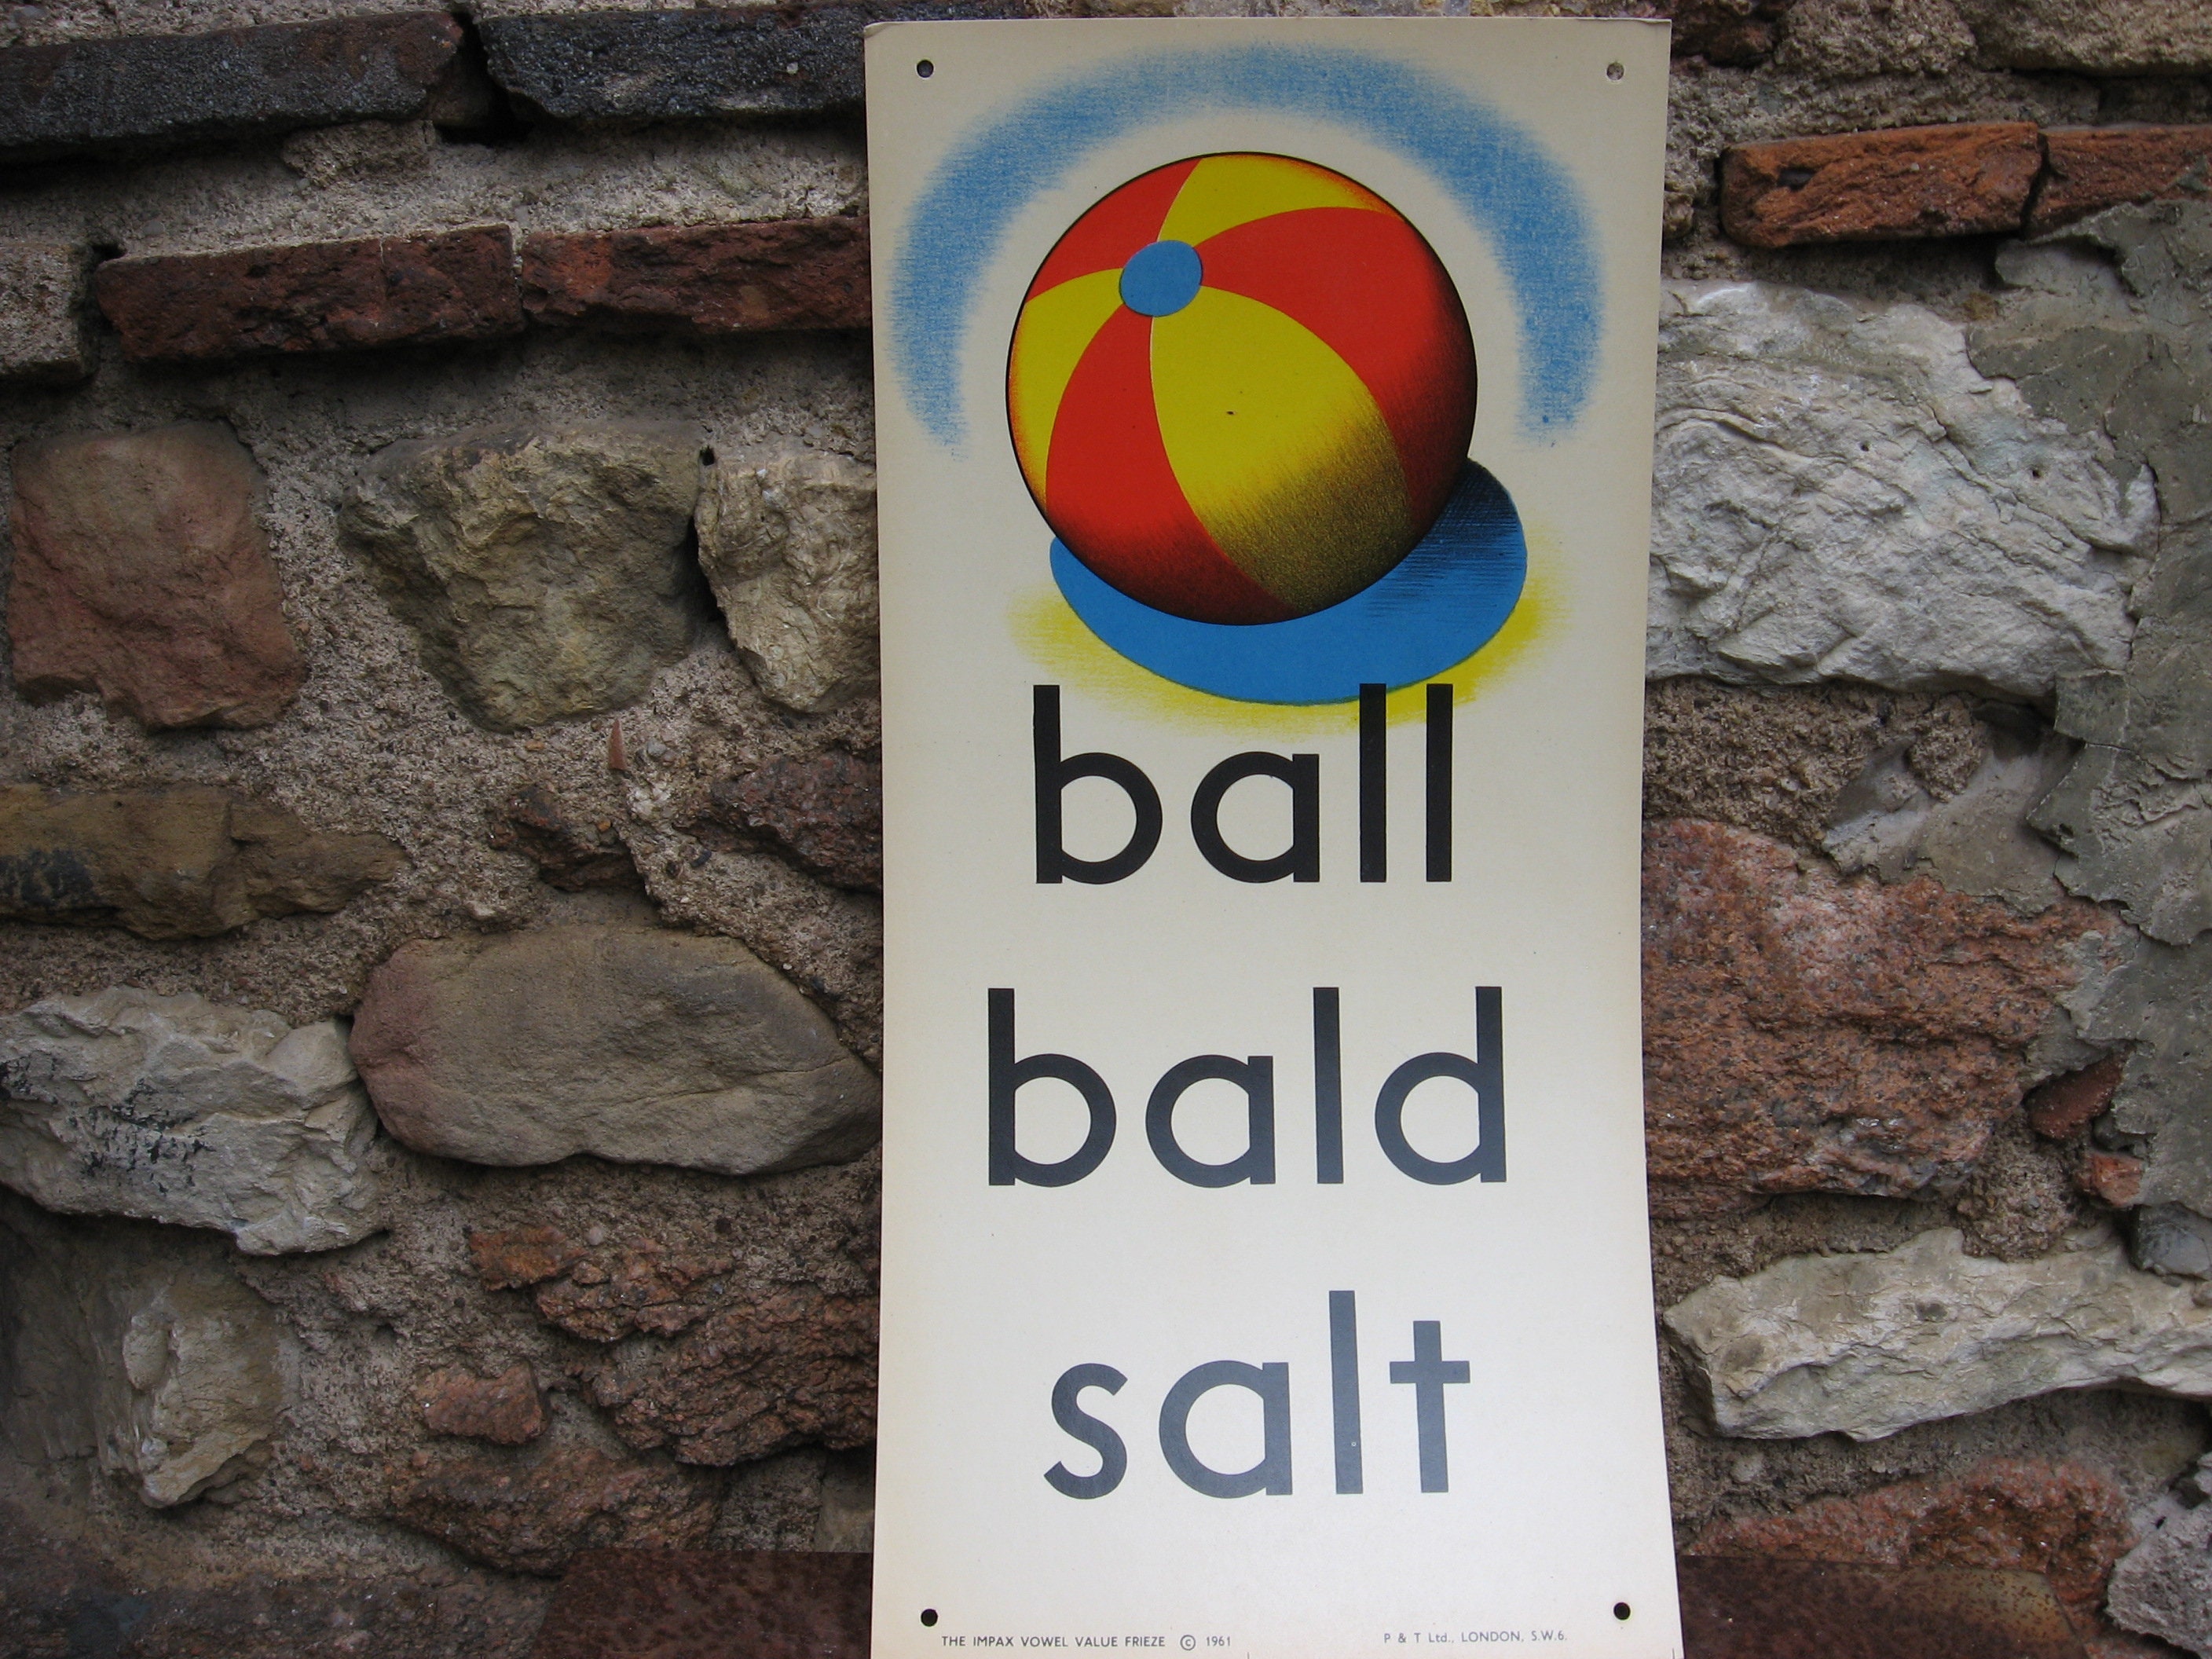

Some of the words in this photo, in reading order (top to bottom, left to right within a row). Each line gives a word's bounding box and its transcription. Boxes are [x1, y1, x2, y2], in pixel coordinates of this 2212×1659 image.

[1034, 683, 1453, 885] ball
[988, 987, 1507, 1188] bald
[1044, 1290, 1470, 1500] salt
[942, 1635, 965, 1646] THE
[973, 1636, 1013, 1647] IMPAX
[1020, 1636, 1068, 1647] VOWEL
[1075, 1636, 1118, 1647] VALUE
[1125, 1636, 1165, 1647] FRIEZE
[1206, 1636, 1231, 1647] 1961
[1384, 1633, 1391, 1643] P
[1397, 1633, 1407, 1643] &
[1414, 1632, 1421, 1643] T
